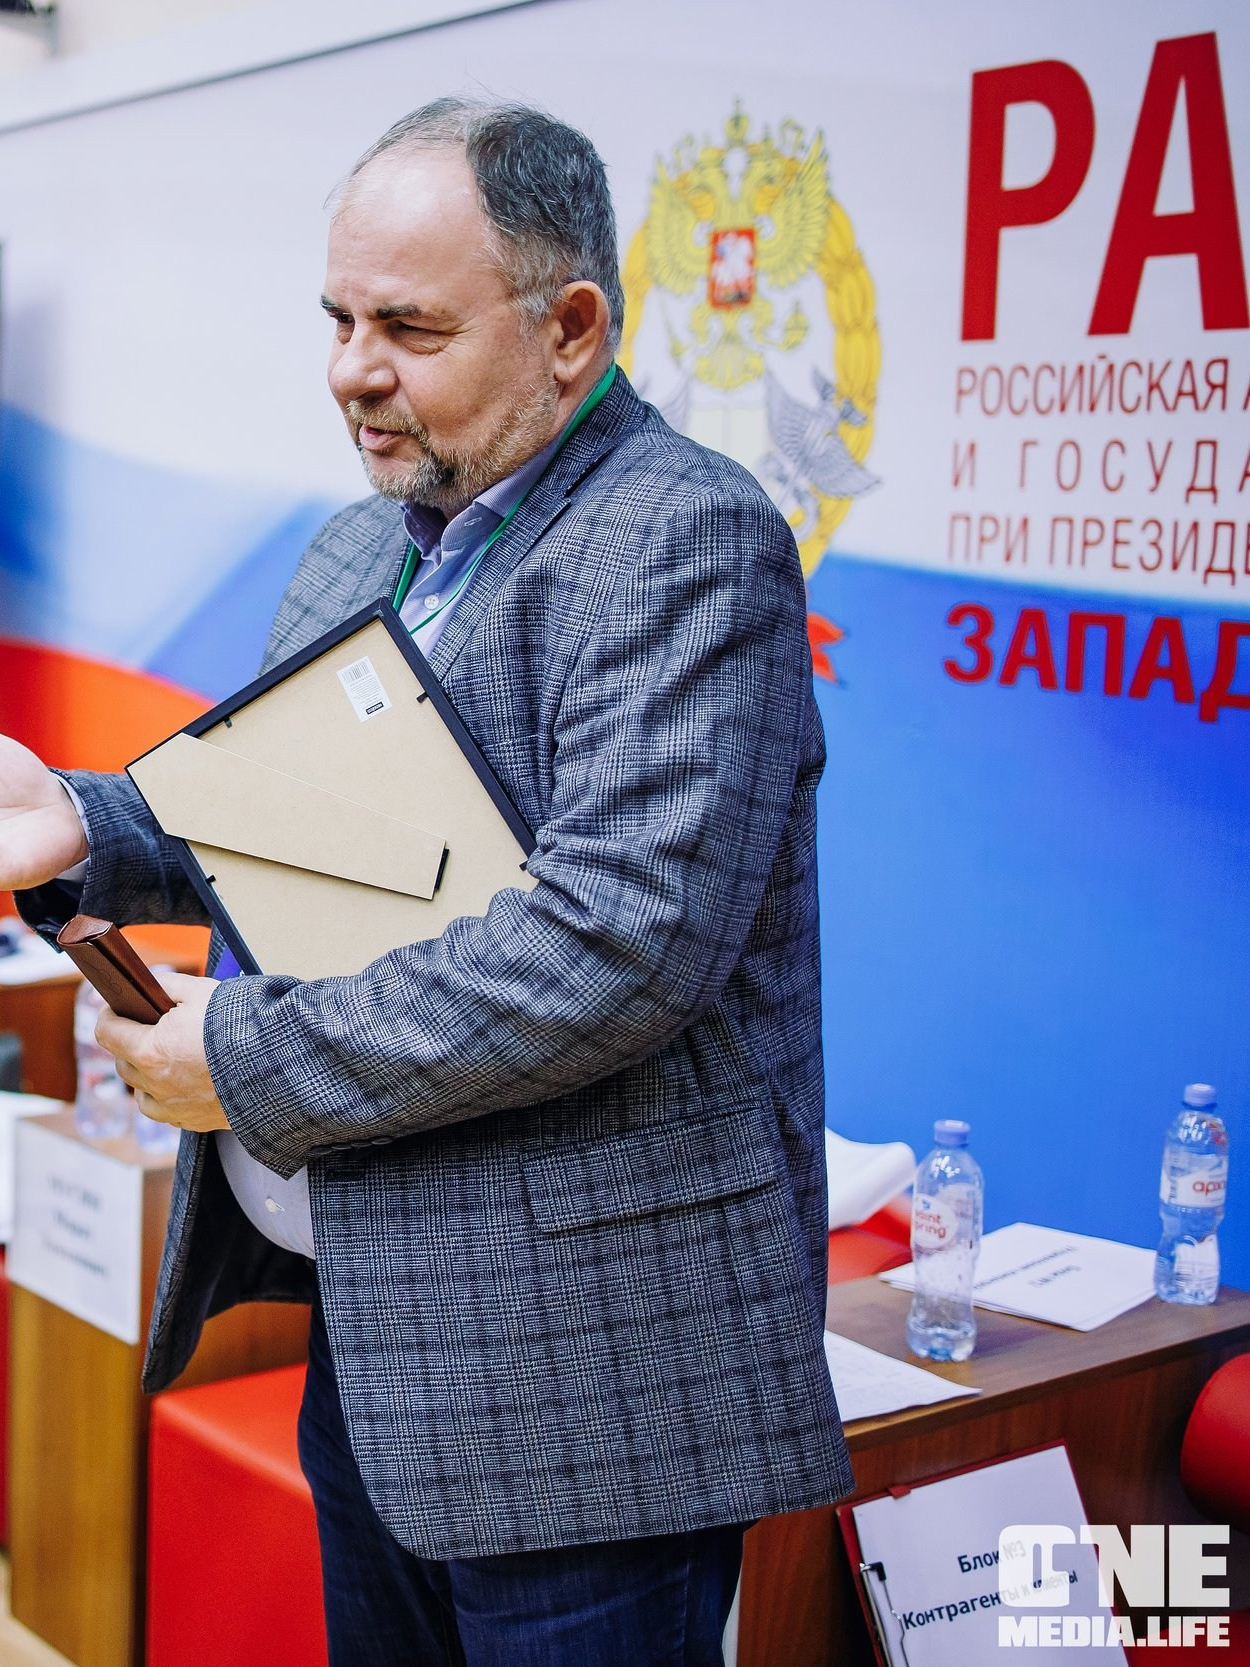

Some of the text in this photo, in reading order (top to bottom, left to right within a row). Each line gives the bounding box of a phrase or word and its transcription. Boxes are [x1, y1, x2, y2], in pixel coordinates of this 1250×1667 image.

[960, 30, 1250, 342] РА
[954, 354, 1230, 416] РОССИЙСКАЯ
[951, 439, 977, 489] И
[947, 512, 1029, 565] ПРИ
[943, 603, 1250, 723] ЗАПАД
[957, 1550, 1001, 1574] Блок
